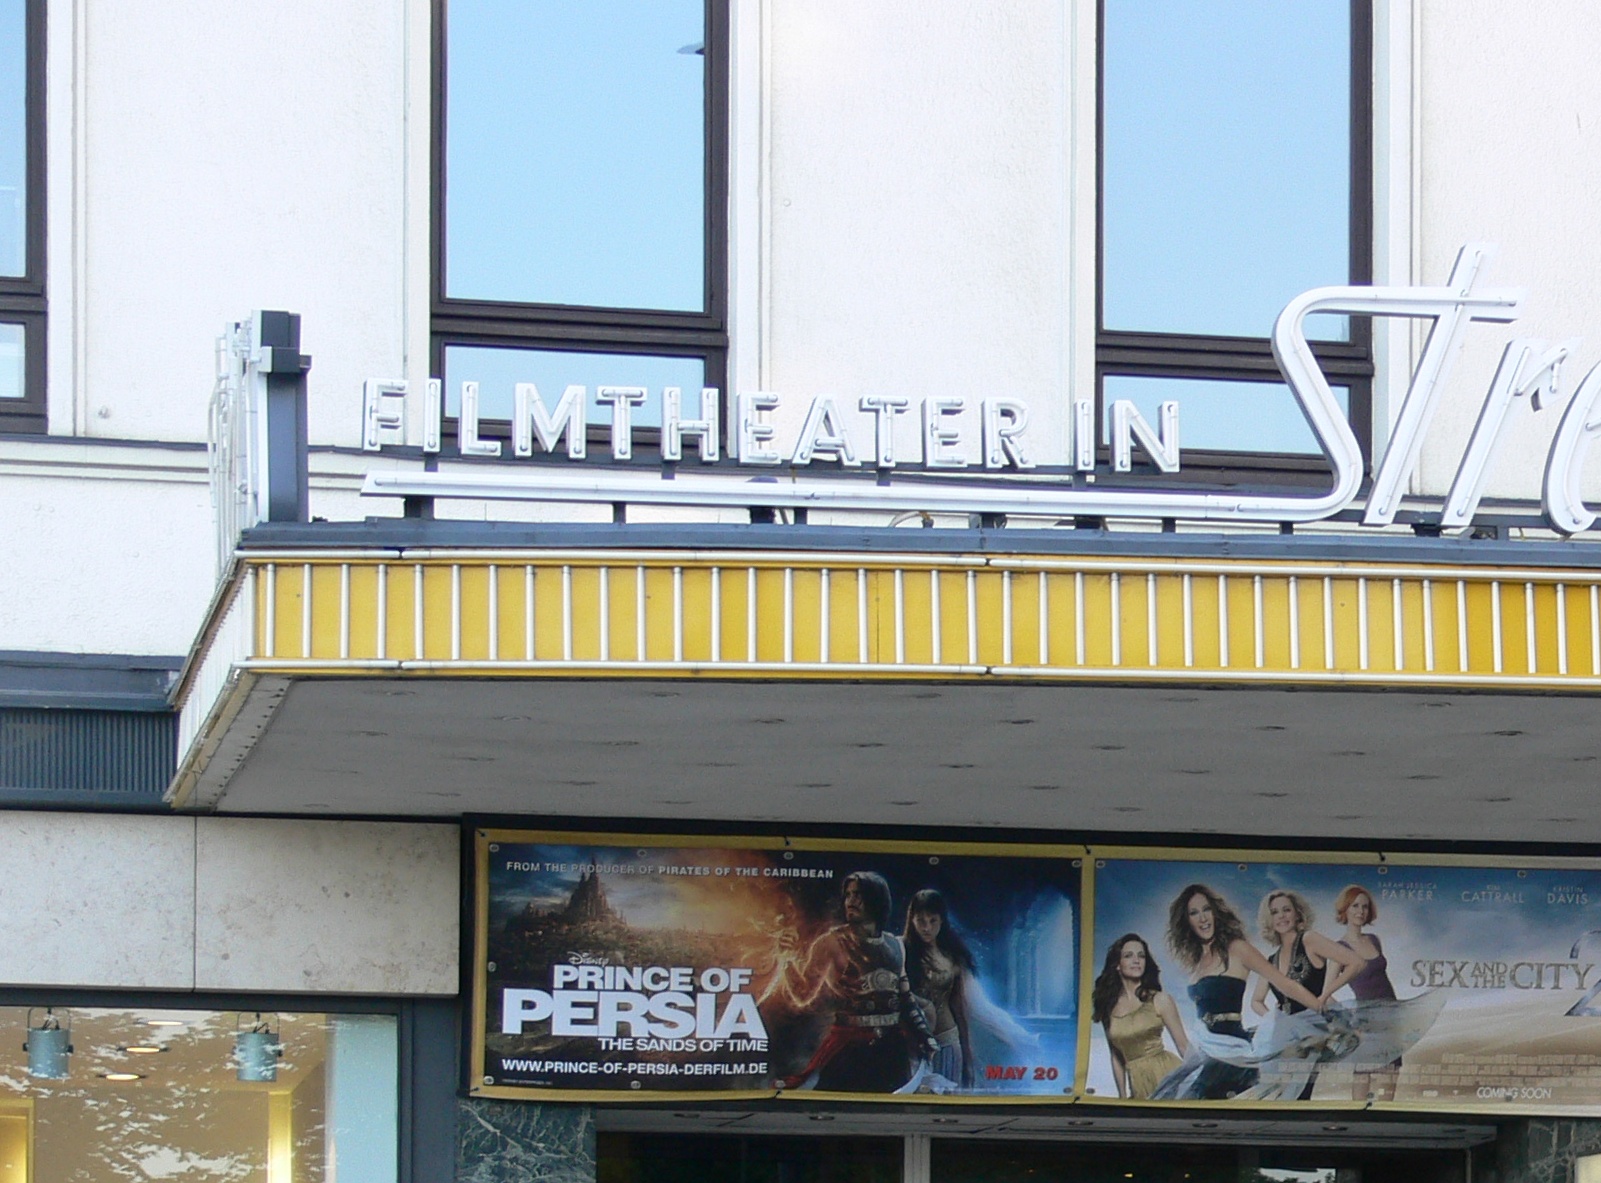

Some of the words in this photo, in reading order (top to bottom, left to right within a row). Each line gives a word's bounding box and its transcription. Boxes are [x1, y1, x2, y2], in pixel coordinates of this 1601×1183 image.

[363, 378, 1036, 471] FILMTHEATER
[1073, 398, 1180, 474] IN
[506, 861, 541, 872] FROM
[545, 862, 567, 873] THE
[571, 863, 635, 875] PRODUCER
[639, 865, 654, 875] OF
[658, 866, 710, 877] PIRATES
[714, 866, 731, 877] OF
[735, 867, 759, 877] THE
[763, 867, 834, 879] CARIBBEAN
[1381, 889, 1433, 901] PARKER
[1461, 890, 1525, 904] CATTRALL
[1547, 892, 1588, 905] DAVIS
[553, 964, 694, 992] PRINCE
[700, 967, 753, 993] OF
[1410, 959, 1470, 989] SEX
[1470, 961, 1508, 976] AND
[1508, 961, 1595, 990] CITY
[1472, 974, 1506, 989] THE
[502, 987, 769, 1039] PERSIA
[598, 1037, 635, 1052] THE
[636, 1038, 697, 1052] SANDS
[700, 1038, 724, 1052] OF
[728, 1038, 769, 1053] TIME
[501, 1058, 769, 1076] WWW.PRINCE-OF-PERSIA-DERFILM.DE
[985, 1065, 1028, 1081] MAY
[1033, 1066, 1059, 1081] 20
[1476, 1086, 1518, 1099] COMING
[1520, 1086, 1553, 1100] SOON
